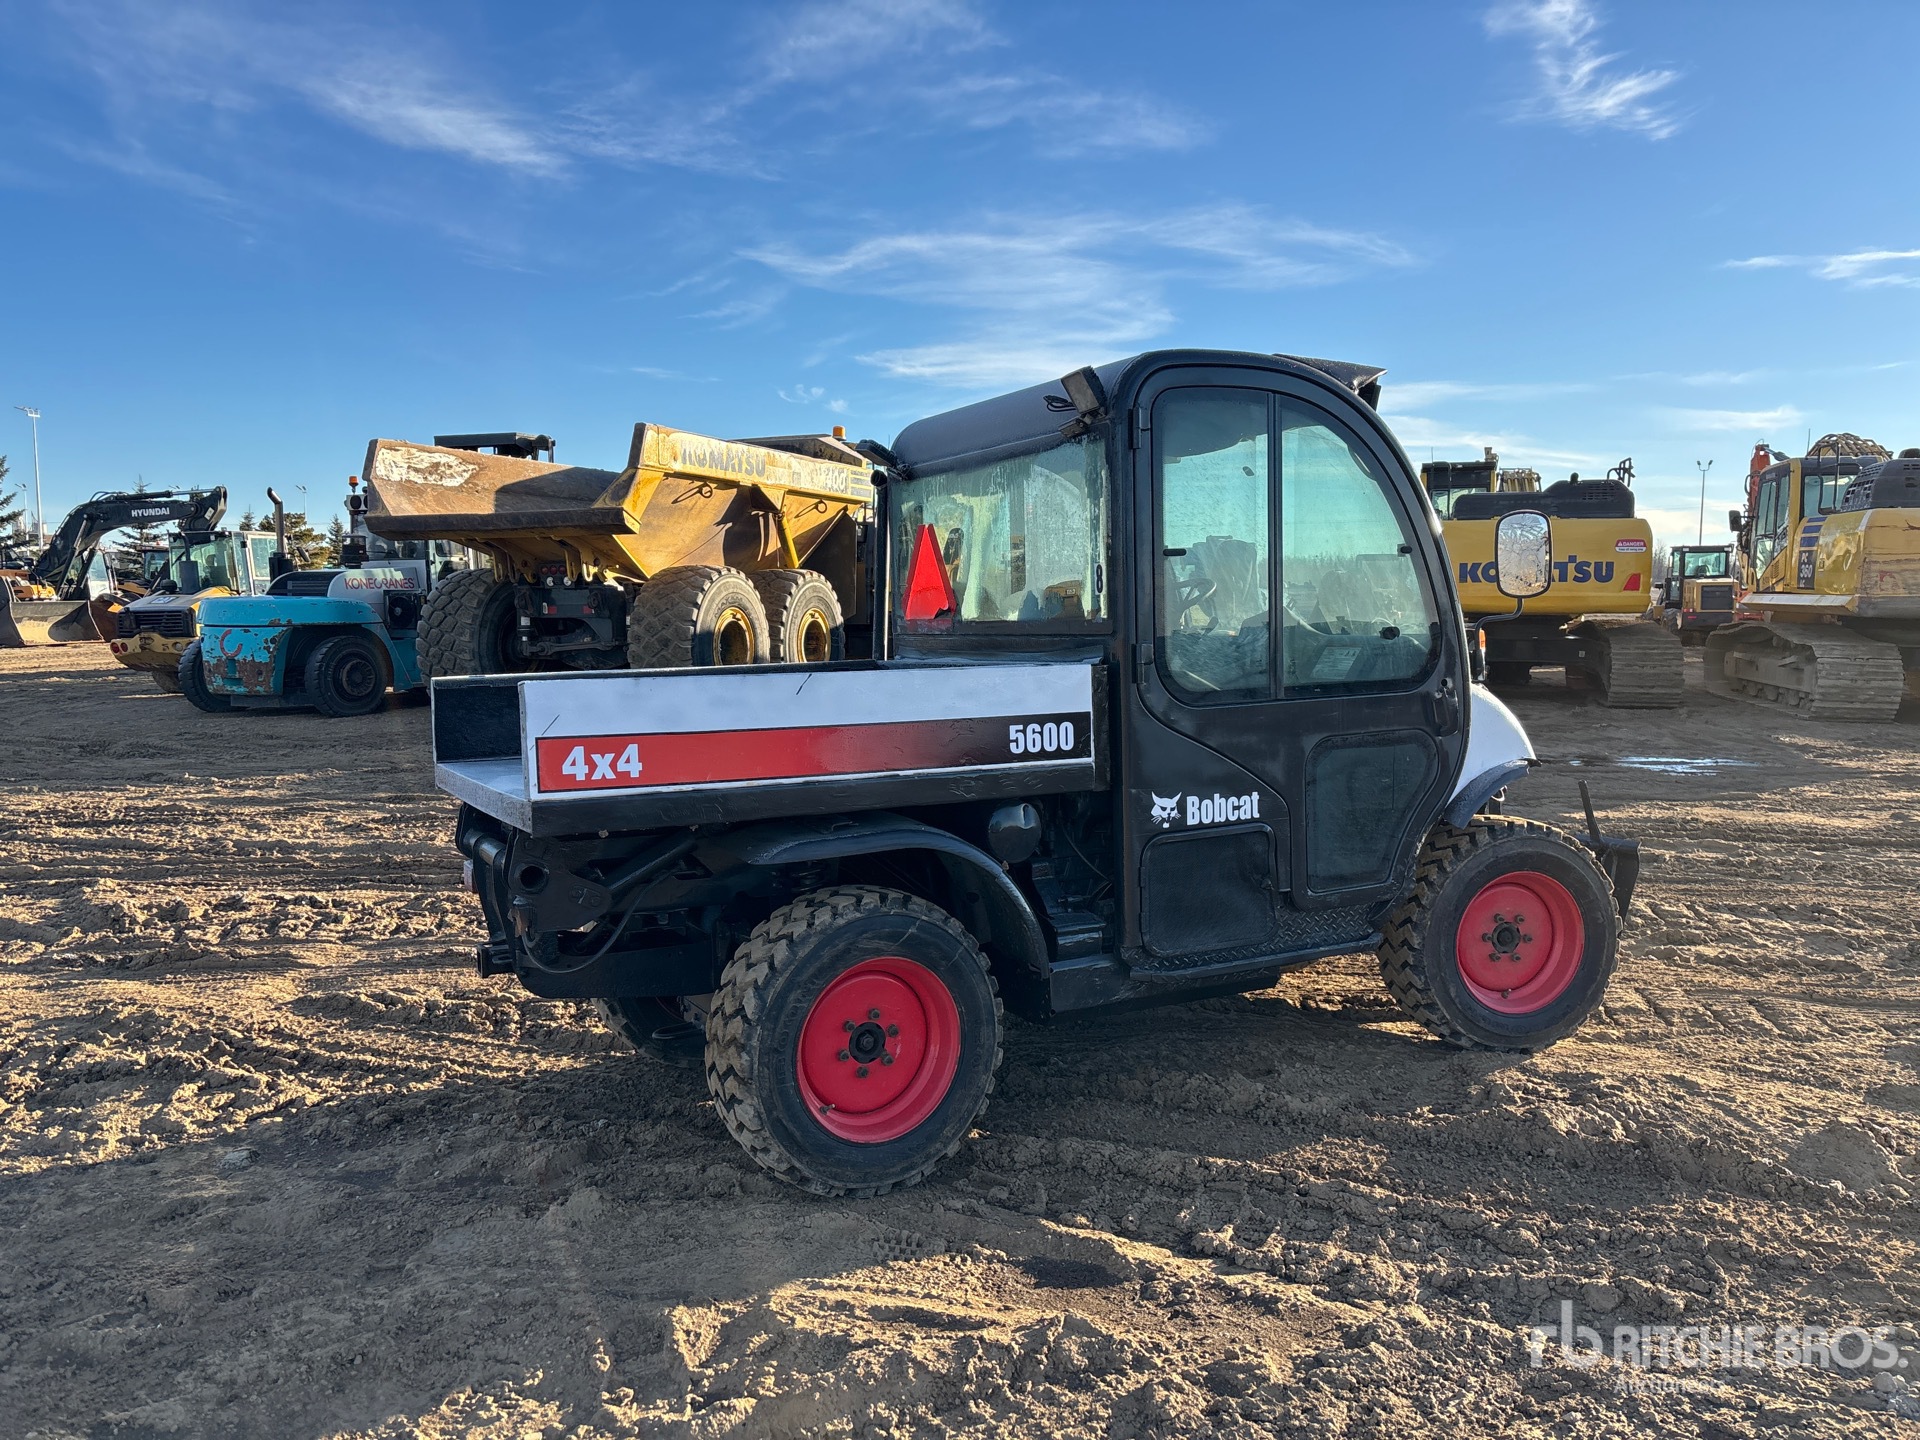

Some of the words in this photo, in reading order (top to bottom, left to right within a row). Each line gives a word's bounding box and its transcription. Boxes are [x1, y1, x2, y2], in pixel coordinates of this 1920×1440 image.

[131, 507, 170, 517] HYUNDAI
[344, 577, 415, 590] KONECRANES
[1459, 555, 1615, 583] KOTSU
[1009, 721, 1074, 754] 5600
[562, 743, 643, 781] 4x4
[1186, 792, 1260, 826] Bobcat
